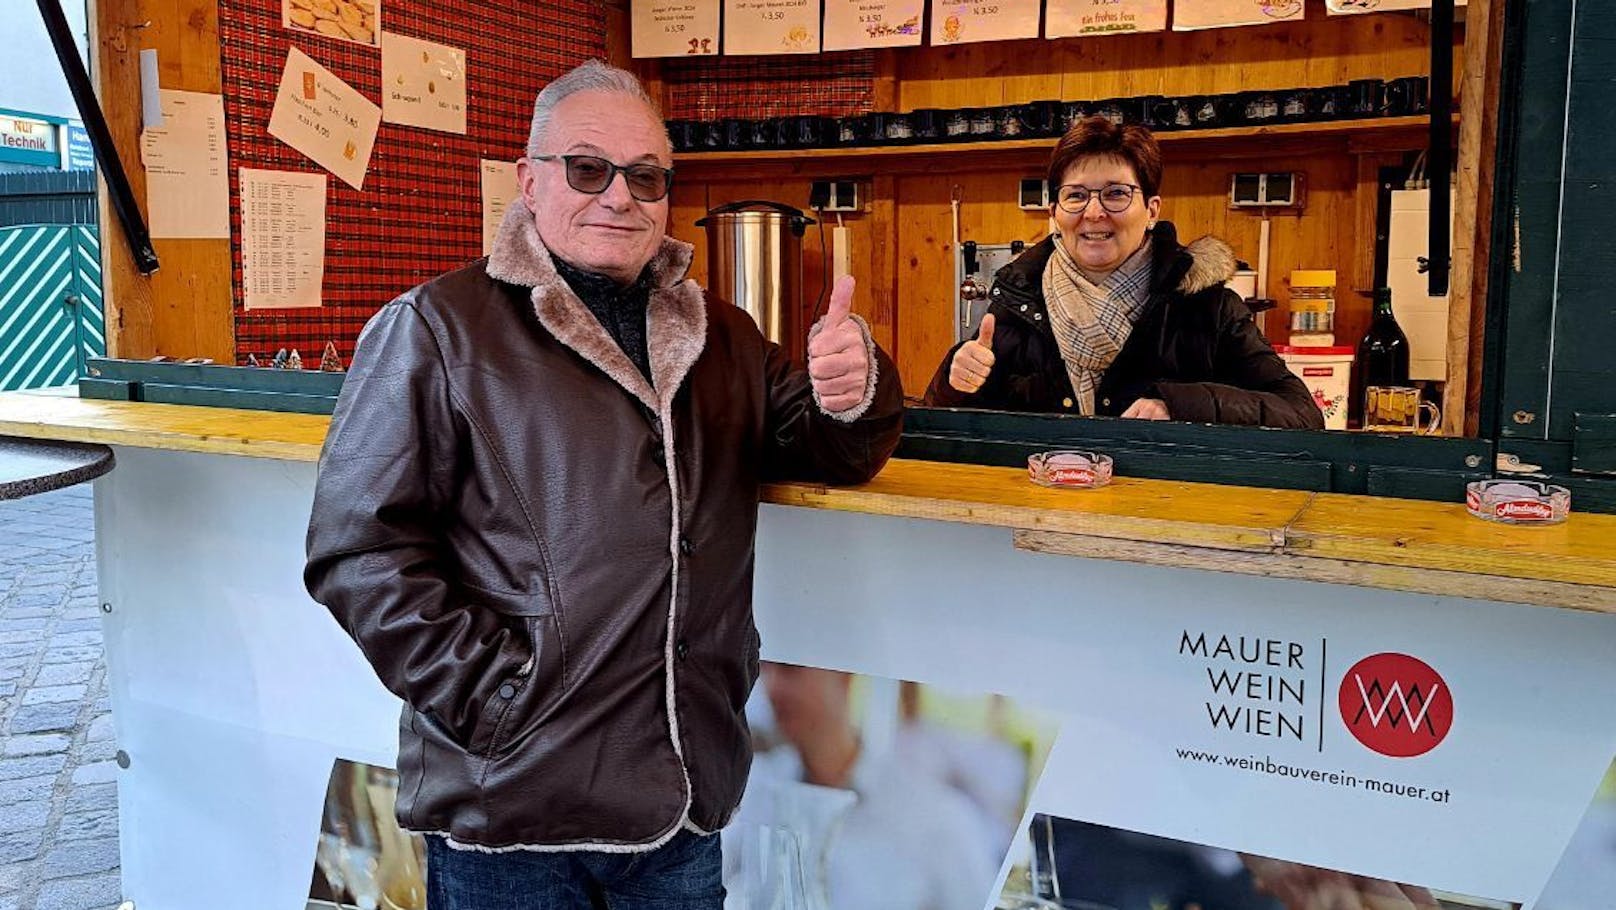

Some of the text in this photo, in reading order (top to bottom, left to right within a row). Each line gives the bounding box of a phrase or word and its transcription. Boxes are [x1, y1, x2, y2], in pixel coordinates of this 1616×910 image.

[1, 133, 47, 150] Technik
[12, 119, 33, 134] Nur
[1179, 630, 1304, 670] MAUER
[1207, 667, 1305, 706] WEIN
[1206, 702, 1304, 741] WIEN
[1176, 748, 1451, 804] www.weinbauverein-mauer.at
